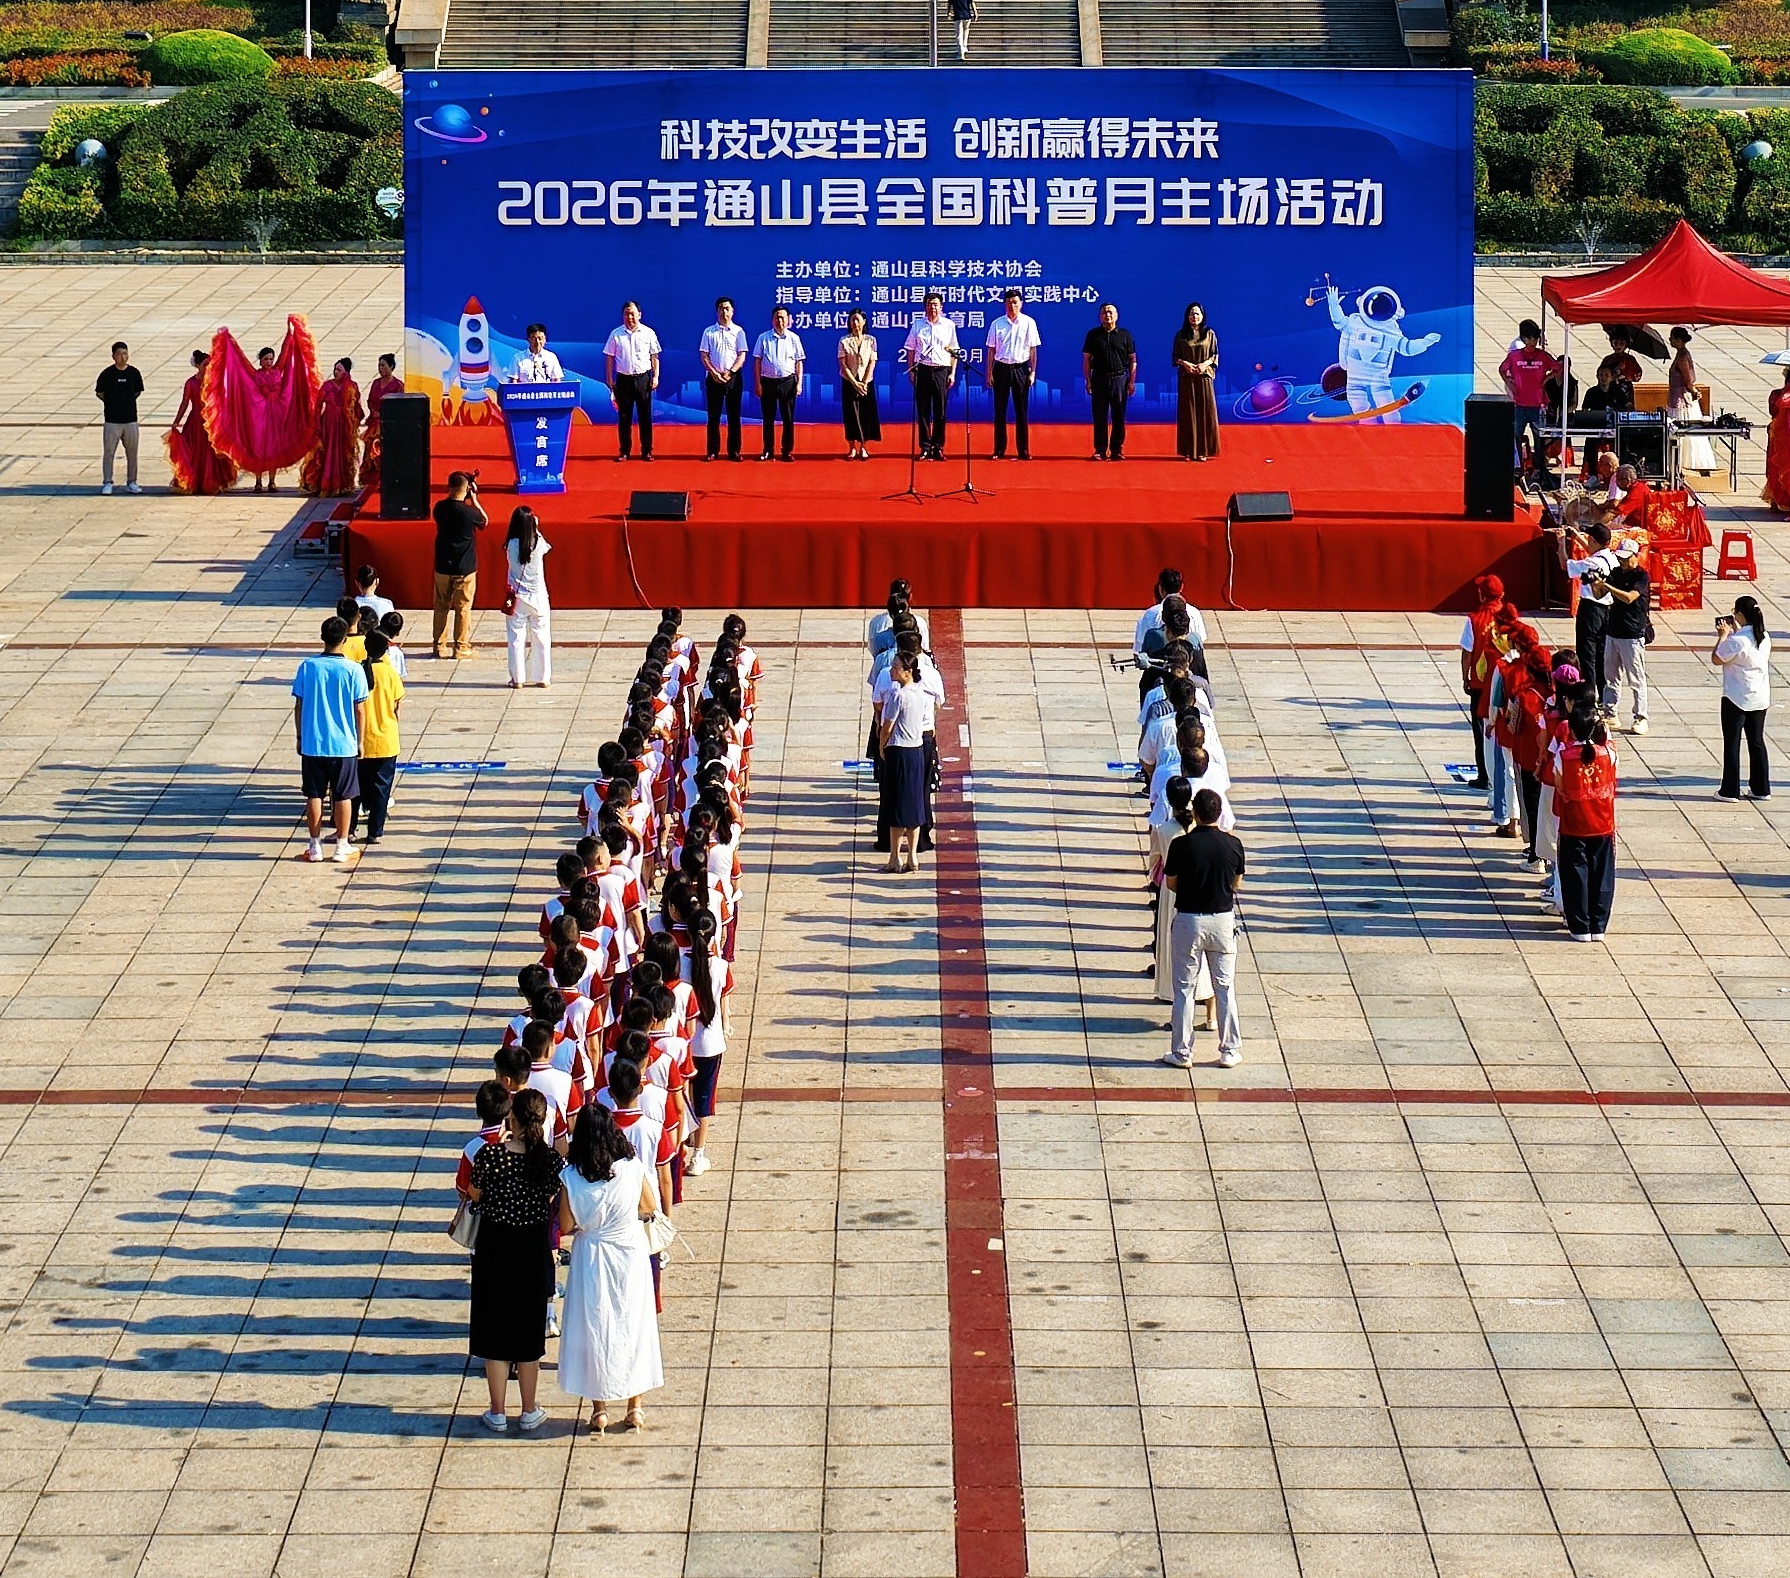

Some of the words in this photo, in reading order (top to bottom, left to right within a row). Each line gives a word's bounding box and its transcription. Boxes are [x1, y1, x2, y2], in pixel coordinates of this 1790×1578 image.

[660, 118, 927, 160] 科技改变生活
[952, 117, 1219, 160] 创新赢得未来
[497, 177, 1383, 227] 2026年通山县全国科普月主场活动
